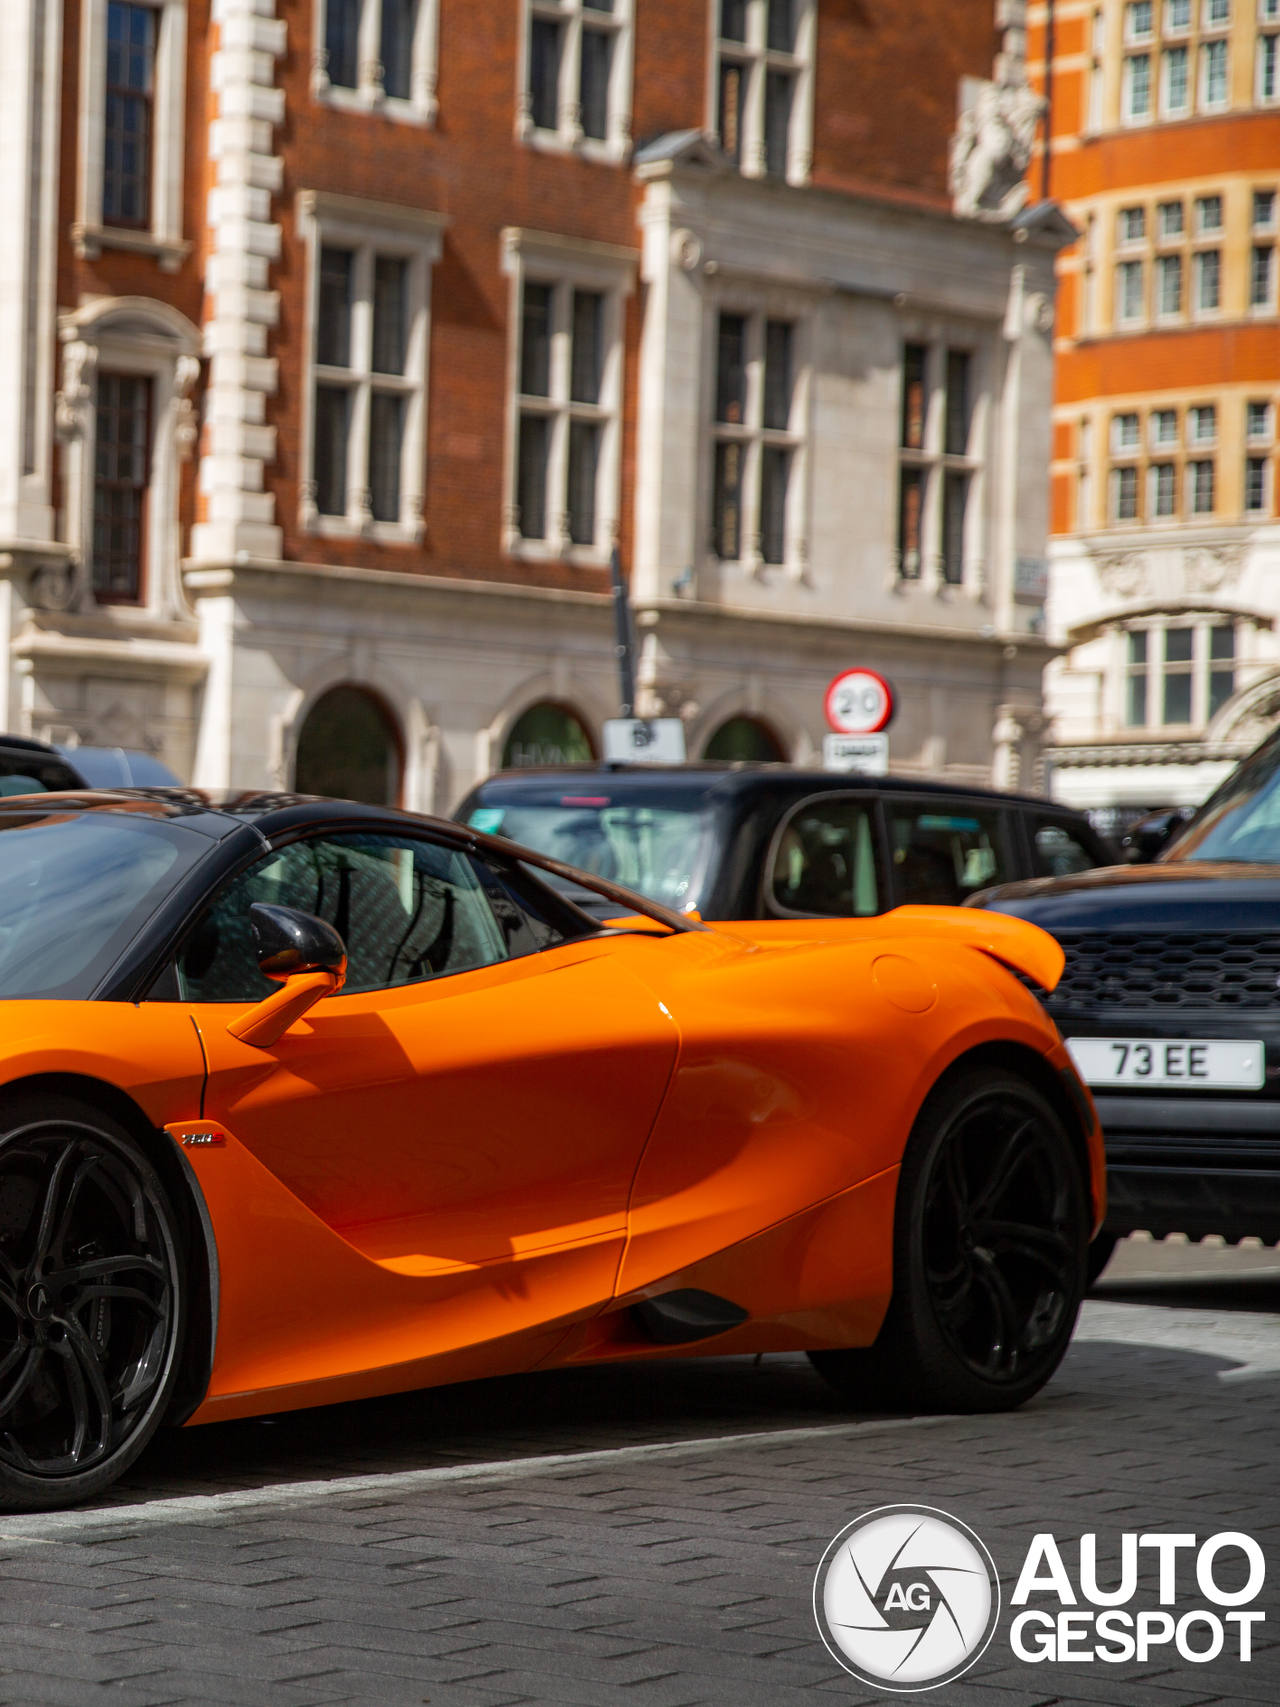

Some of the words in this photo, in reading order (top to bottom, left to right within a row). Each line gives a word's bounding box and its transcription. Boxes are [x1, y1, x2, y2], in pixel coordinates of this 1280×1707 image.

[837, 687, 880, 714] 20
[1112, 1043, 1153, 1075] 73
[1165, 1044, 1209, 1077] EE
